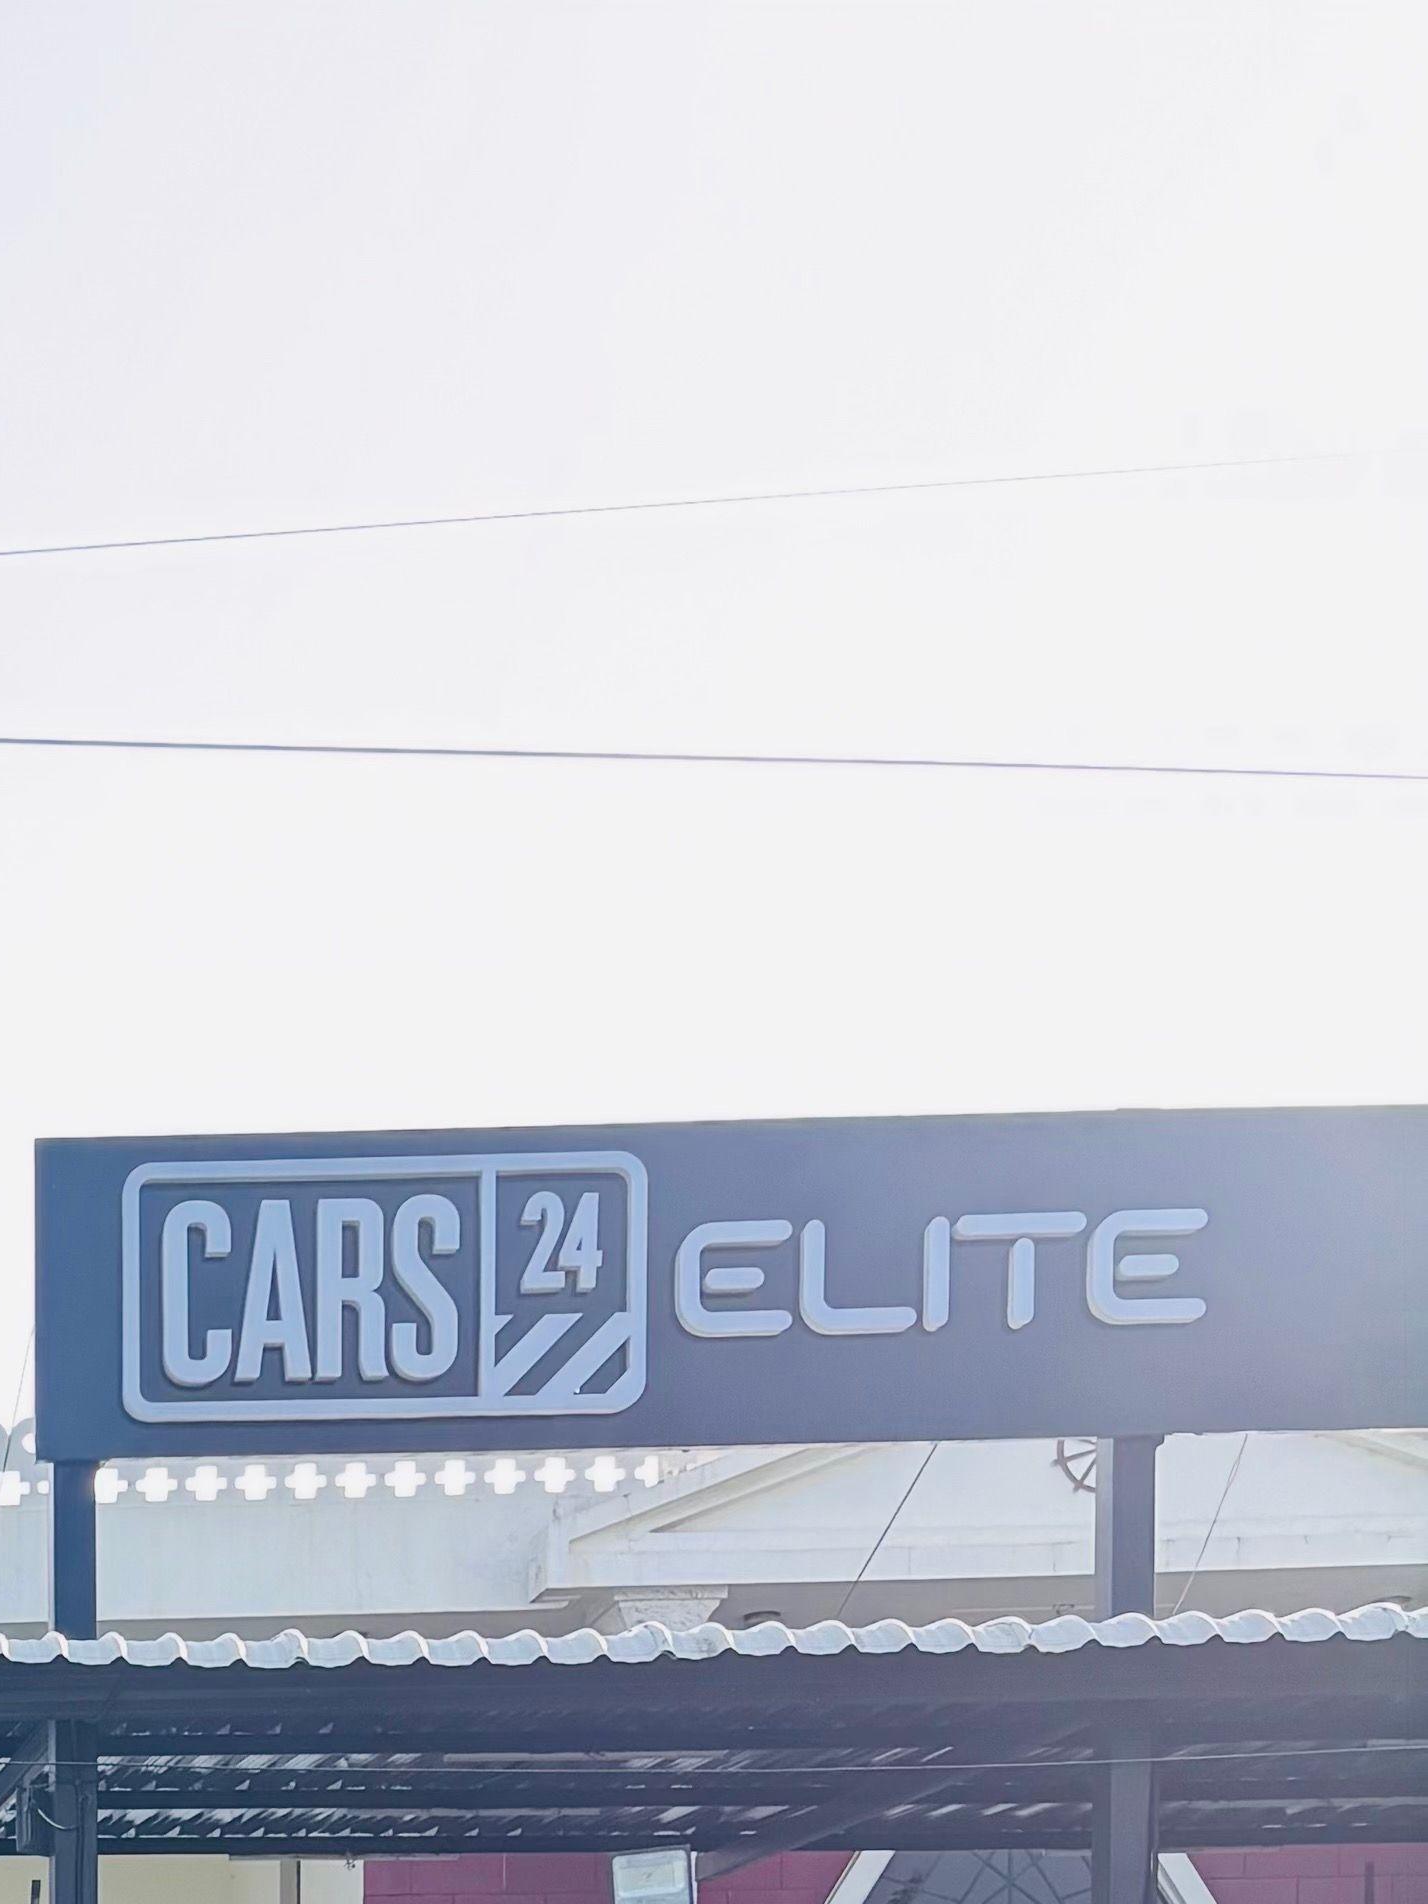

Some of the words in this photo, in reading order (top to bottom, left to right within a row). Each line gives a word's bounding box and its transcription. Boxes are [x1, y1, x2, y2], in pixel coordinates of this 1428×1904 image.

[162, 1194, 461, 1387] CARS
[520, 1190, 603, 1294] 24
[675, 1208, 1208, 1338] ELITE
